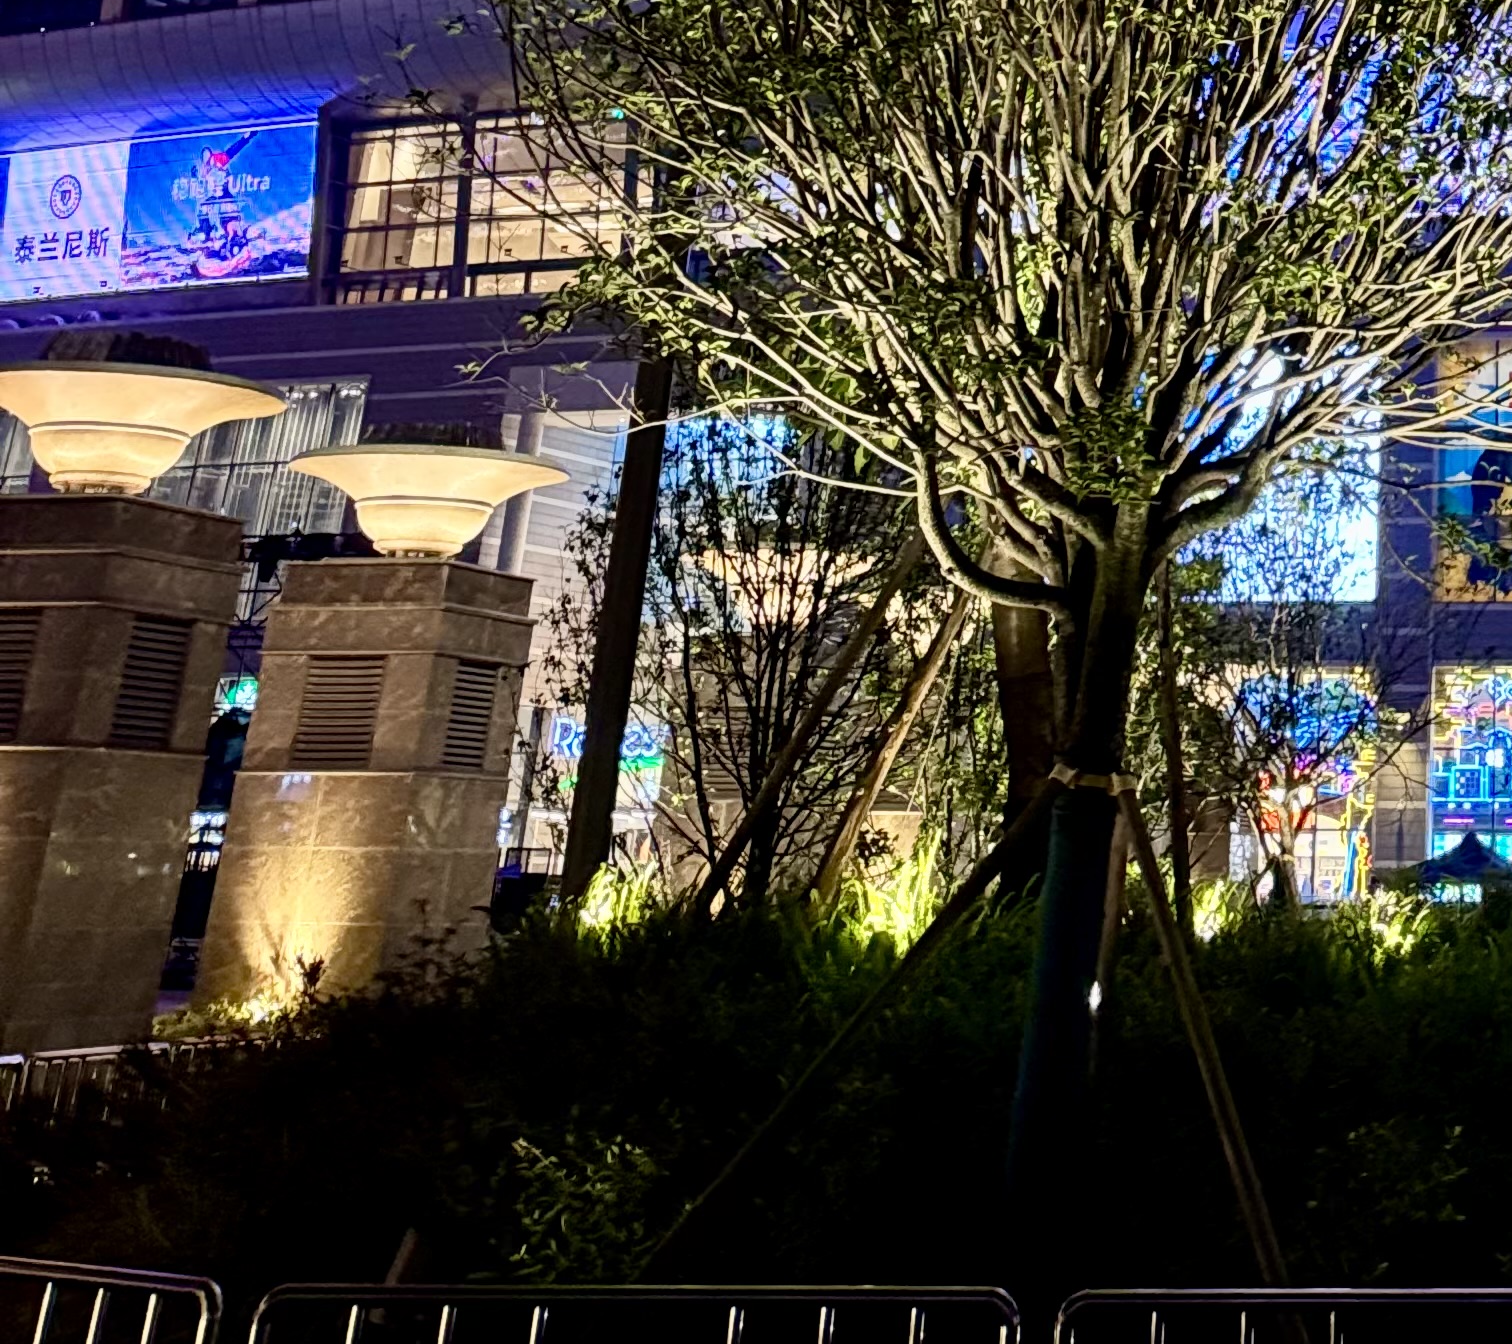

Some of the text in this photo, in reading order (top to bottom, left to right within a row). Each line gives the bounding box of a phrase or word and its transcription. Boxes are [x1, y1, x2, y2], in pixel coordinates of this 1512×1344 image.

[227, 172, 272, 193] Ultra
[14, 226, 110, 265] 泰兰尼斯
